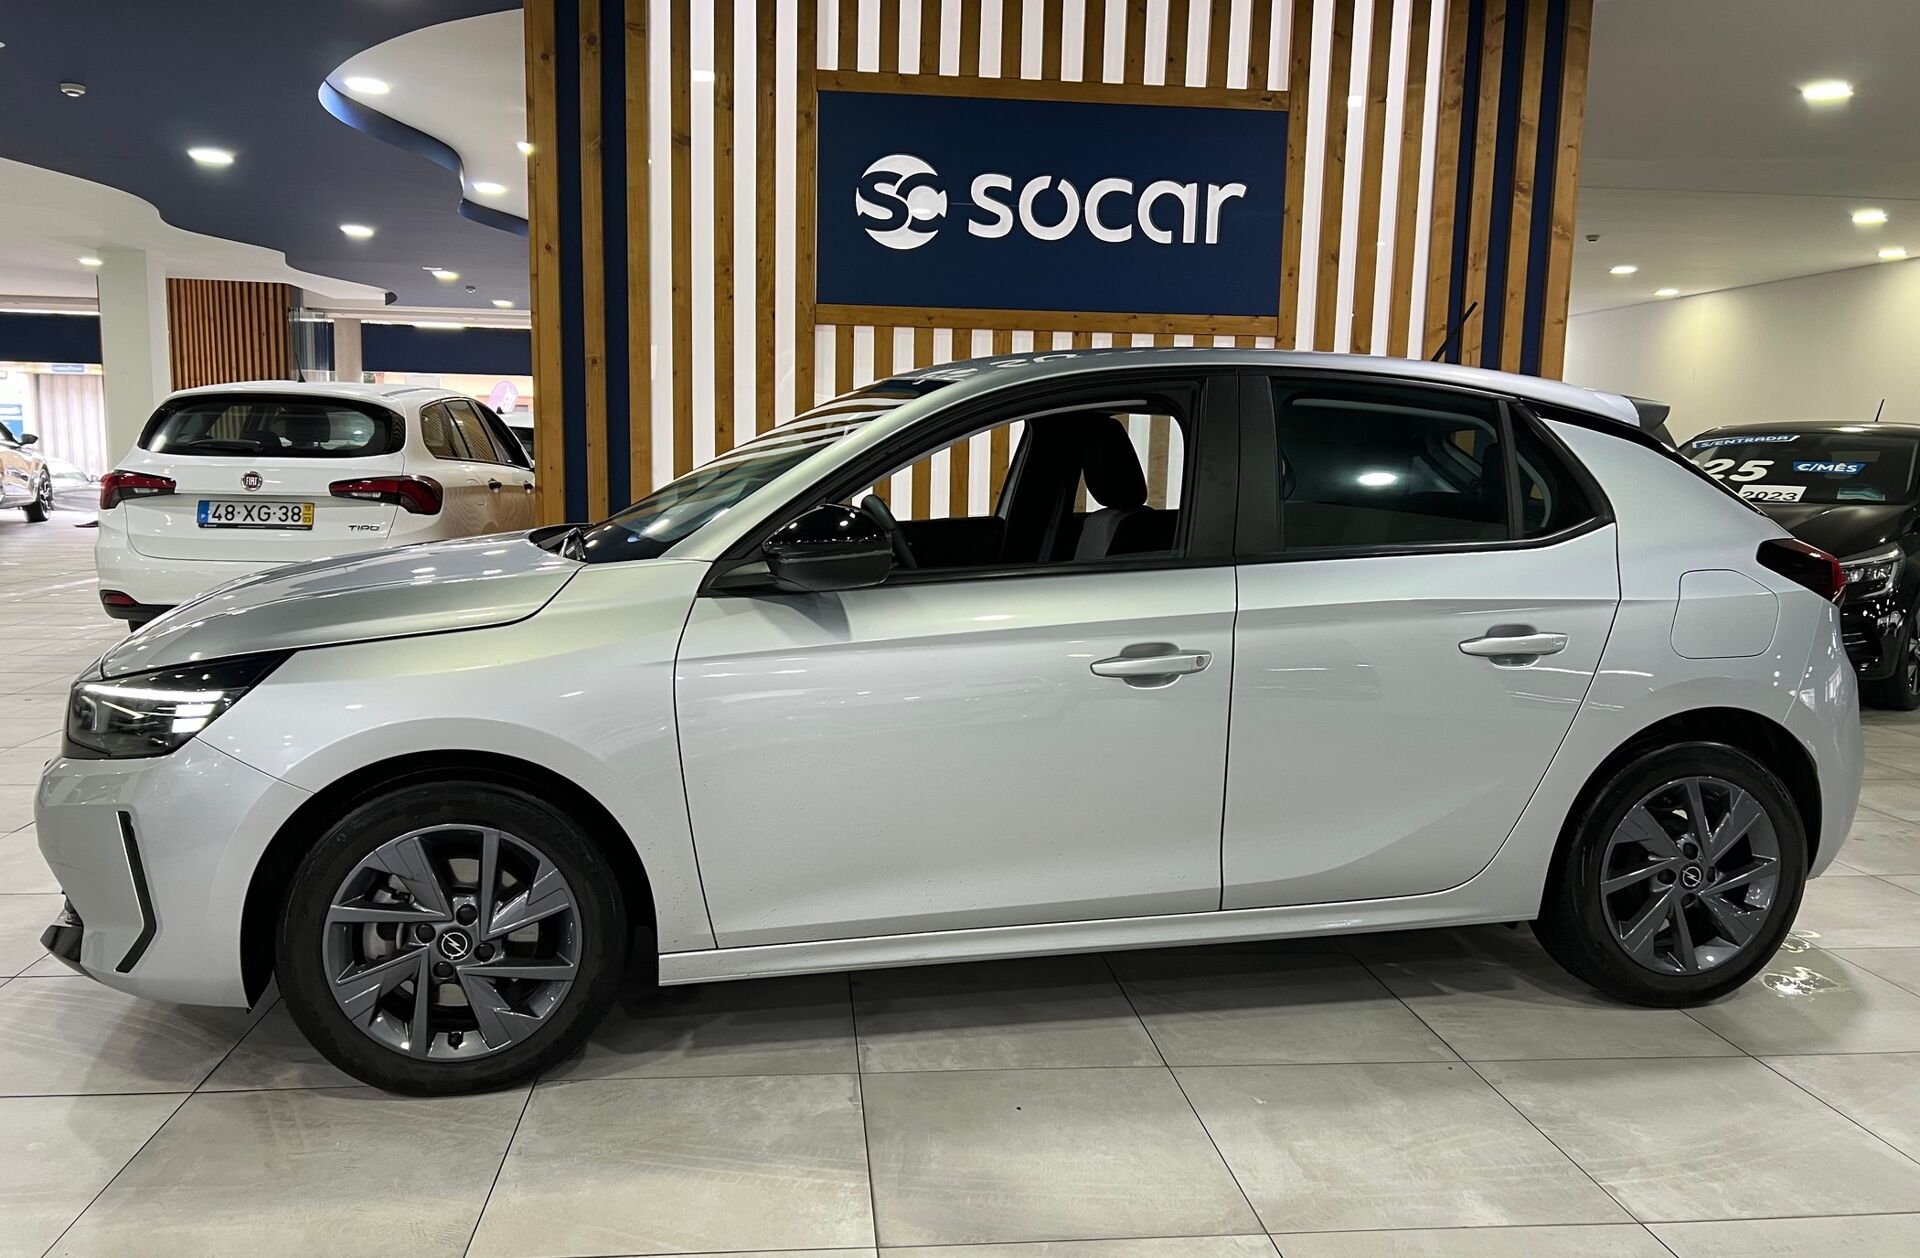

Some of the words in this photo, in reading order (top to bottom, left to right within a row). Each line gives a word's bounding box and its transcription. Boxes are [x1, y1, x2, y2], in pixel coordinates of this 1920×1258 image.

[1700, 435, 1788, 448] S/ENTRADA
[1797, 462, 1857, 473] C/MÊS
[1742, 491, 1798, 501] 2023
